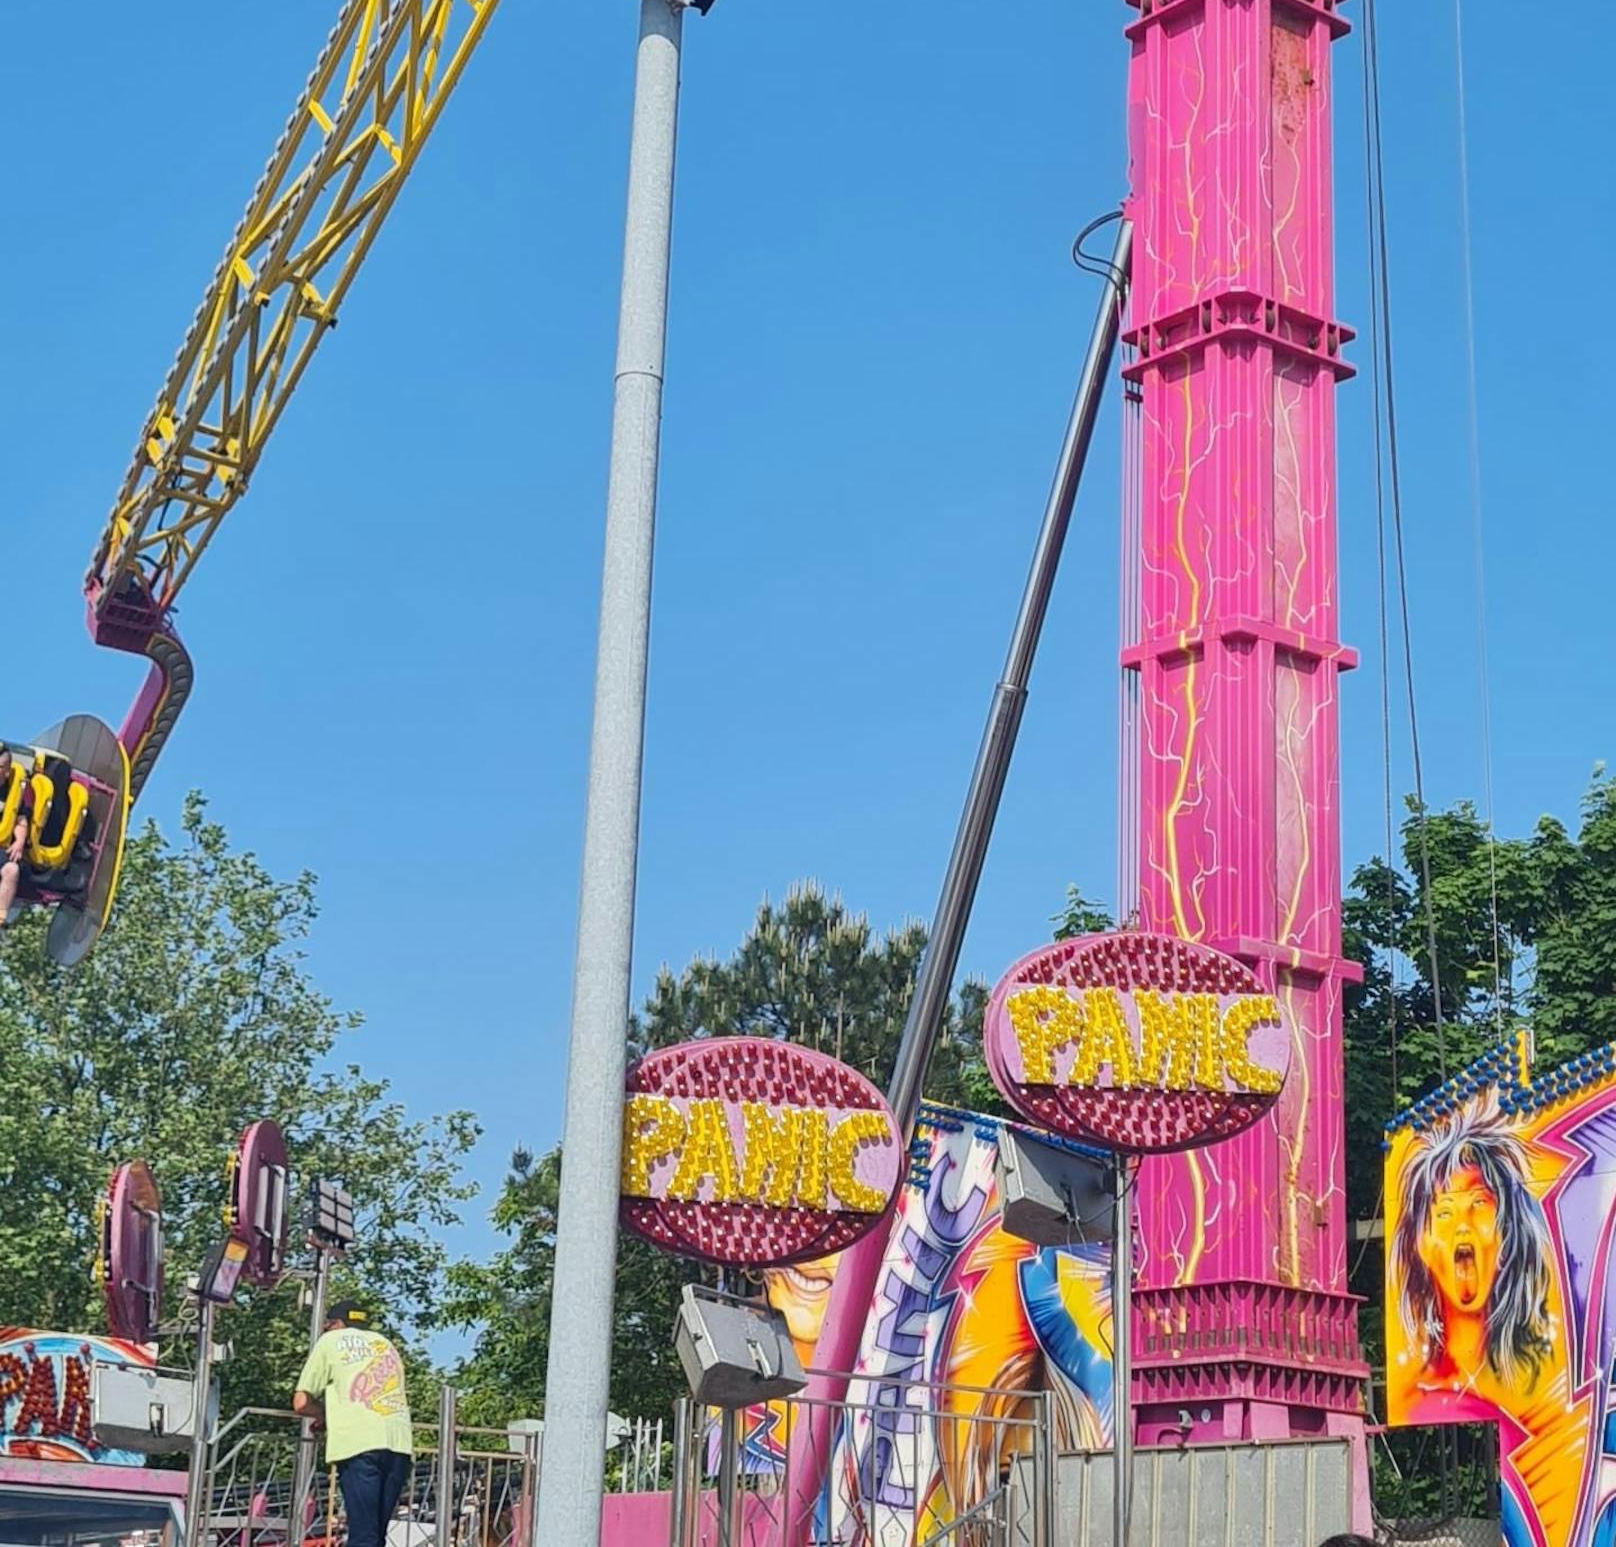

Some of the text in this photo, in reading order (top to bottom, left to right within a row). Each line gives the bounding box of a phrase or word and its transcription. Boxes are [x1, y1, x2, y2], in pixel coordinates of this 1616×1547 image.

[1007, 984, 1281, 1094] PANIC
[622, 1092, 891, 1214] PANIC
[860, 1151, 988, 1511] PANIC
